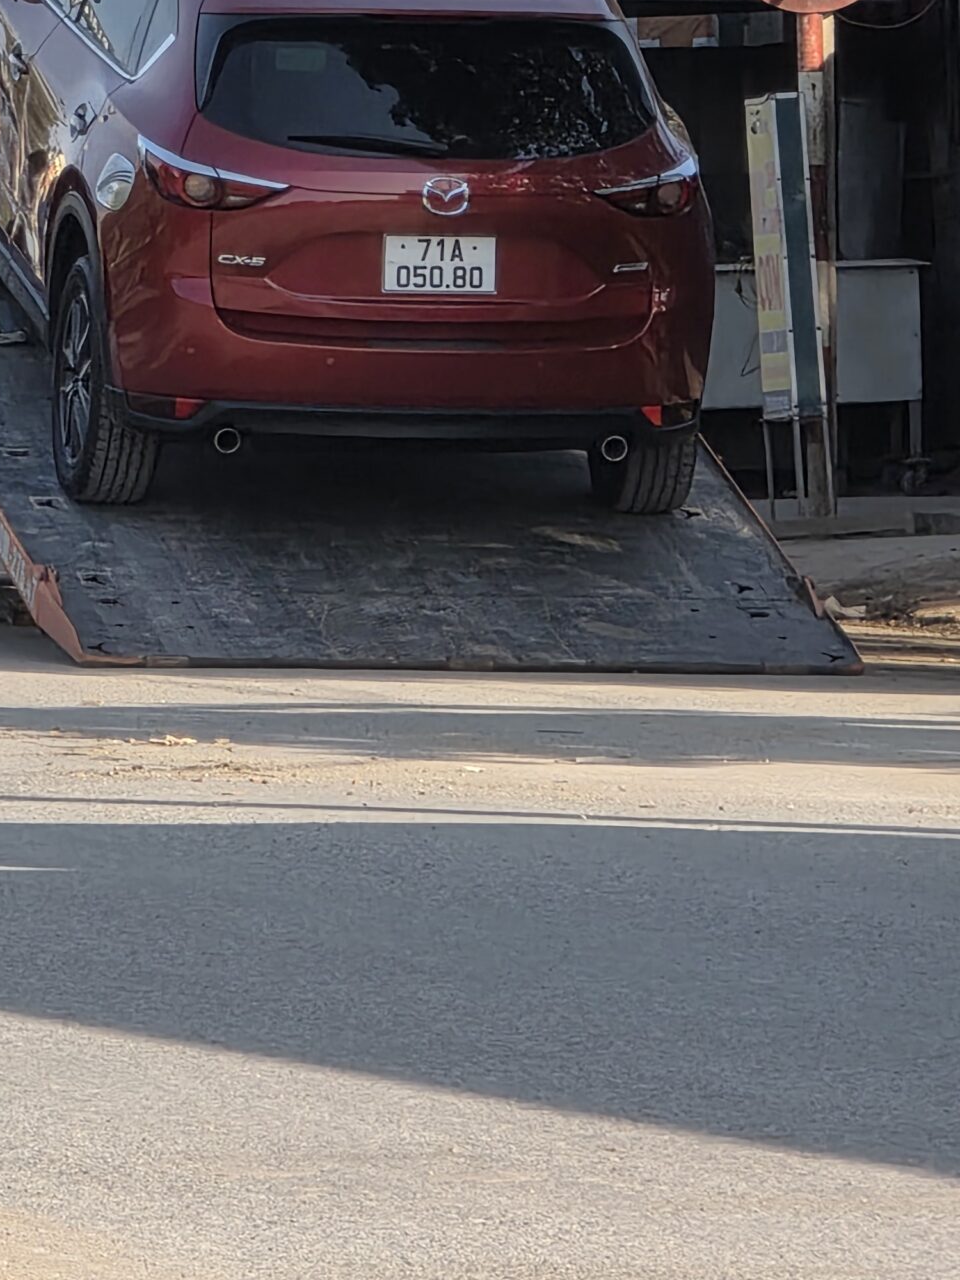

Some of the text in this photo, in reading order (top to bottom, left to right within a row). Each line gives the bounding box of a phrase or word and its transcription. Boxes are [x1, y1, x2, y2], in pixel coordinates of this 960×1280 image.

[217, 254, 267, 267] CX-5
[417, 238, 465, 262] 71A
[396, 265, 483, 289] 050.80
